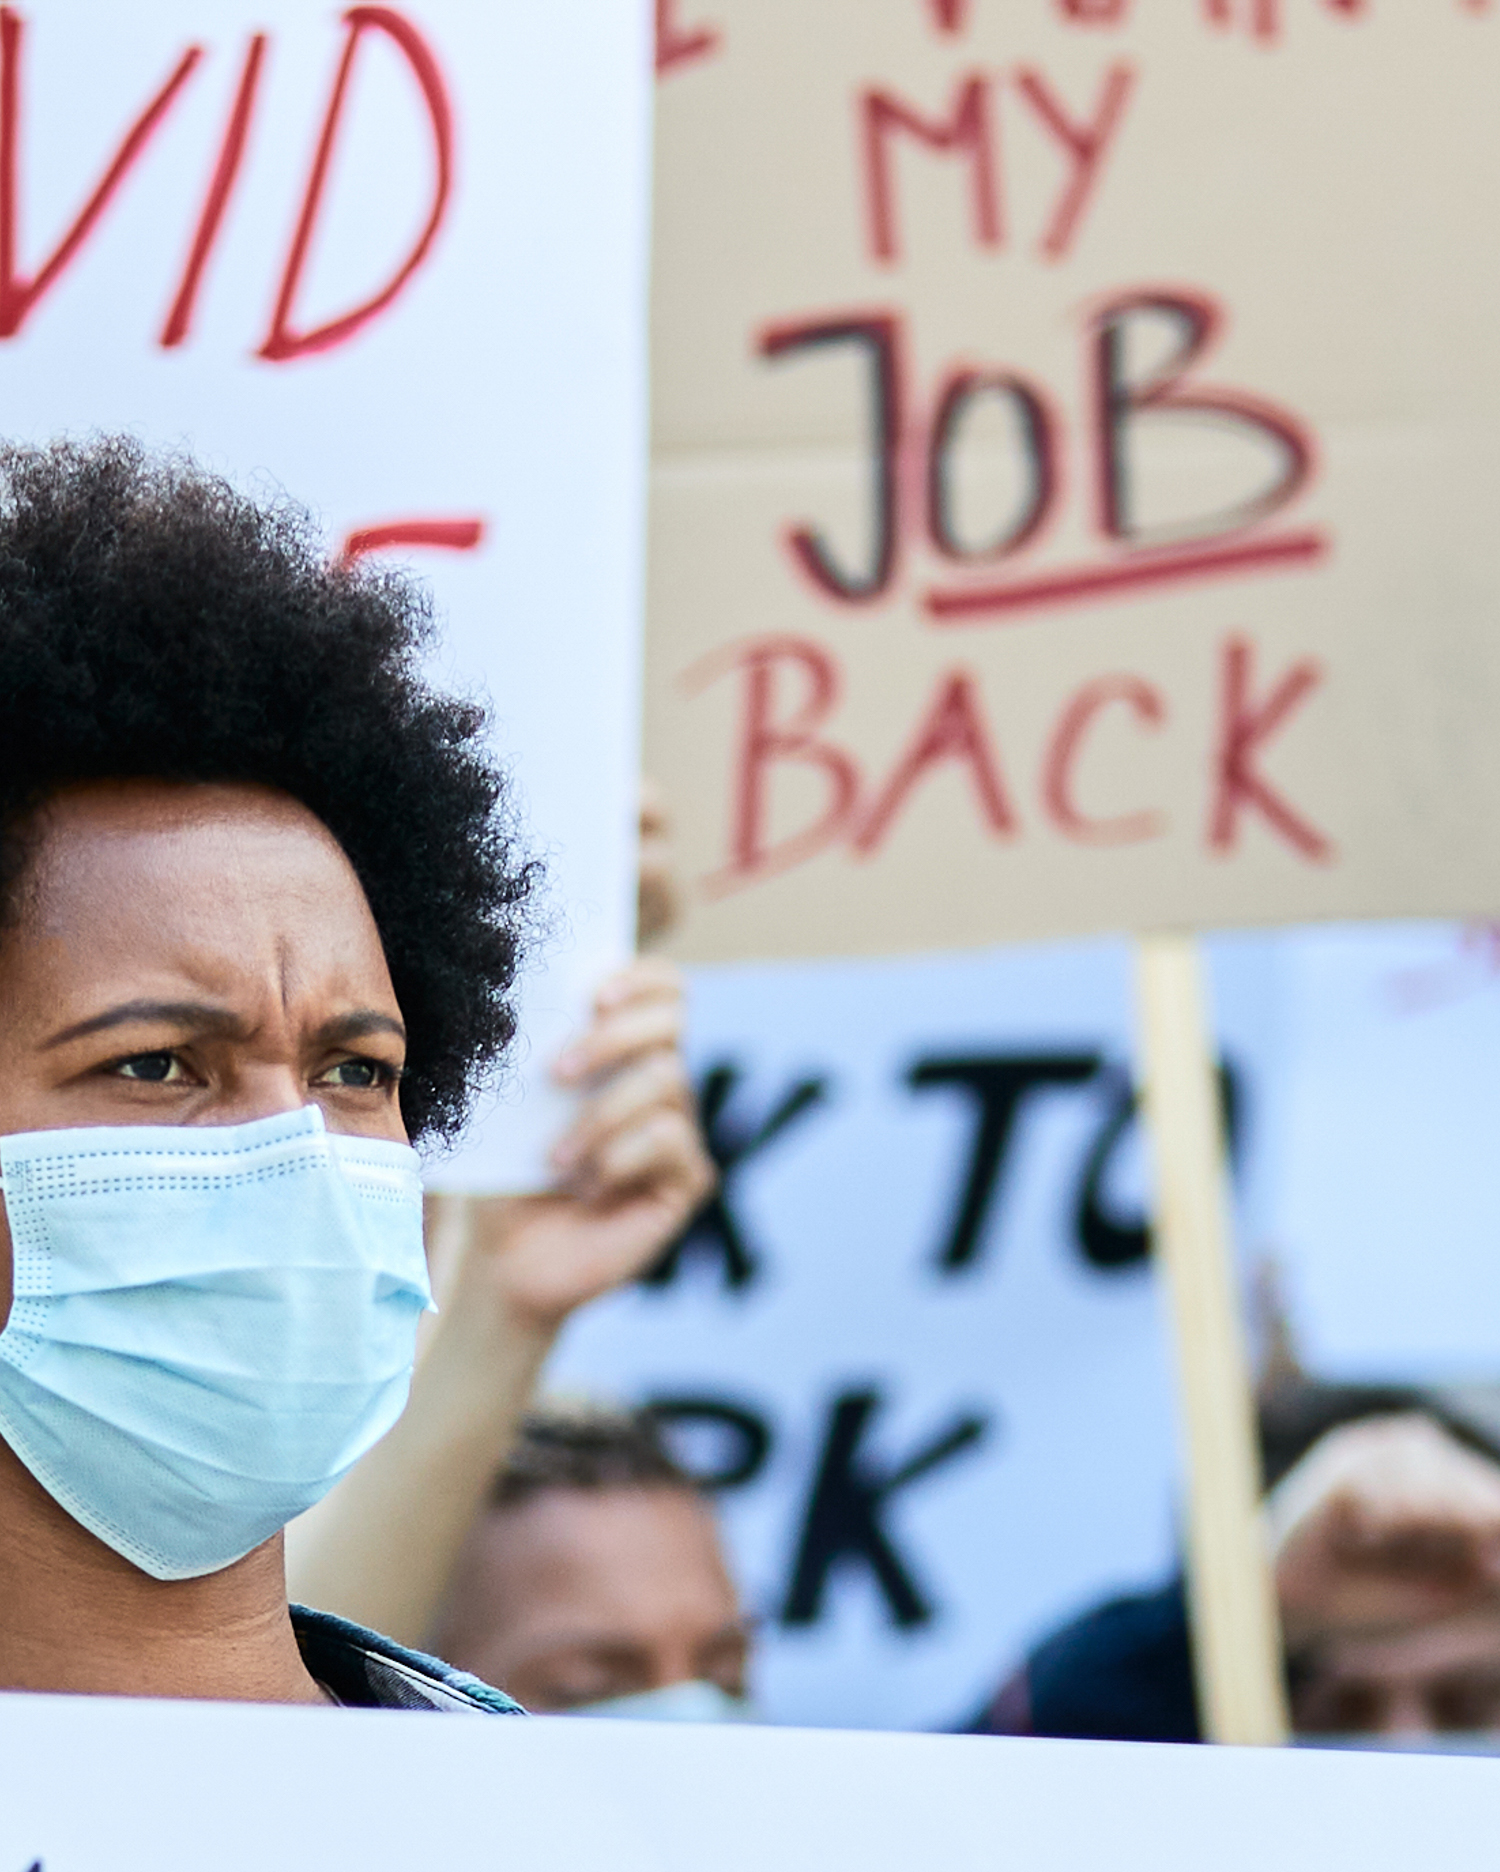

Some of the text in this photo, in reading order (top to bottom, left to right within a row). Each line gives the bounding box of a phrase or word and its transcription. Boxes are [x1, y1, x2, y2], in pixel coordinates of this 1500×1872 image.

[861, 57, 1140, 266] MY
[755, 278, 1318, 608] JOB
[678, 630, 1340, 899] BACK
